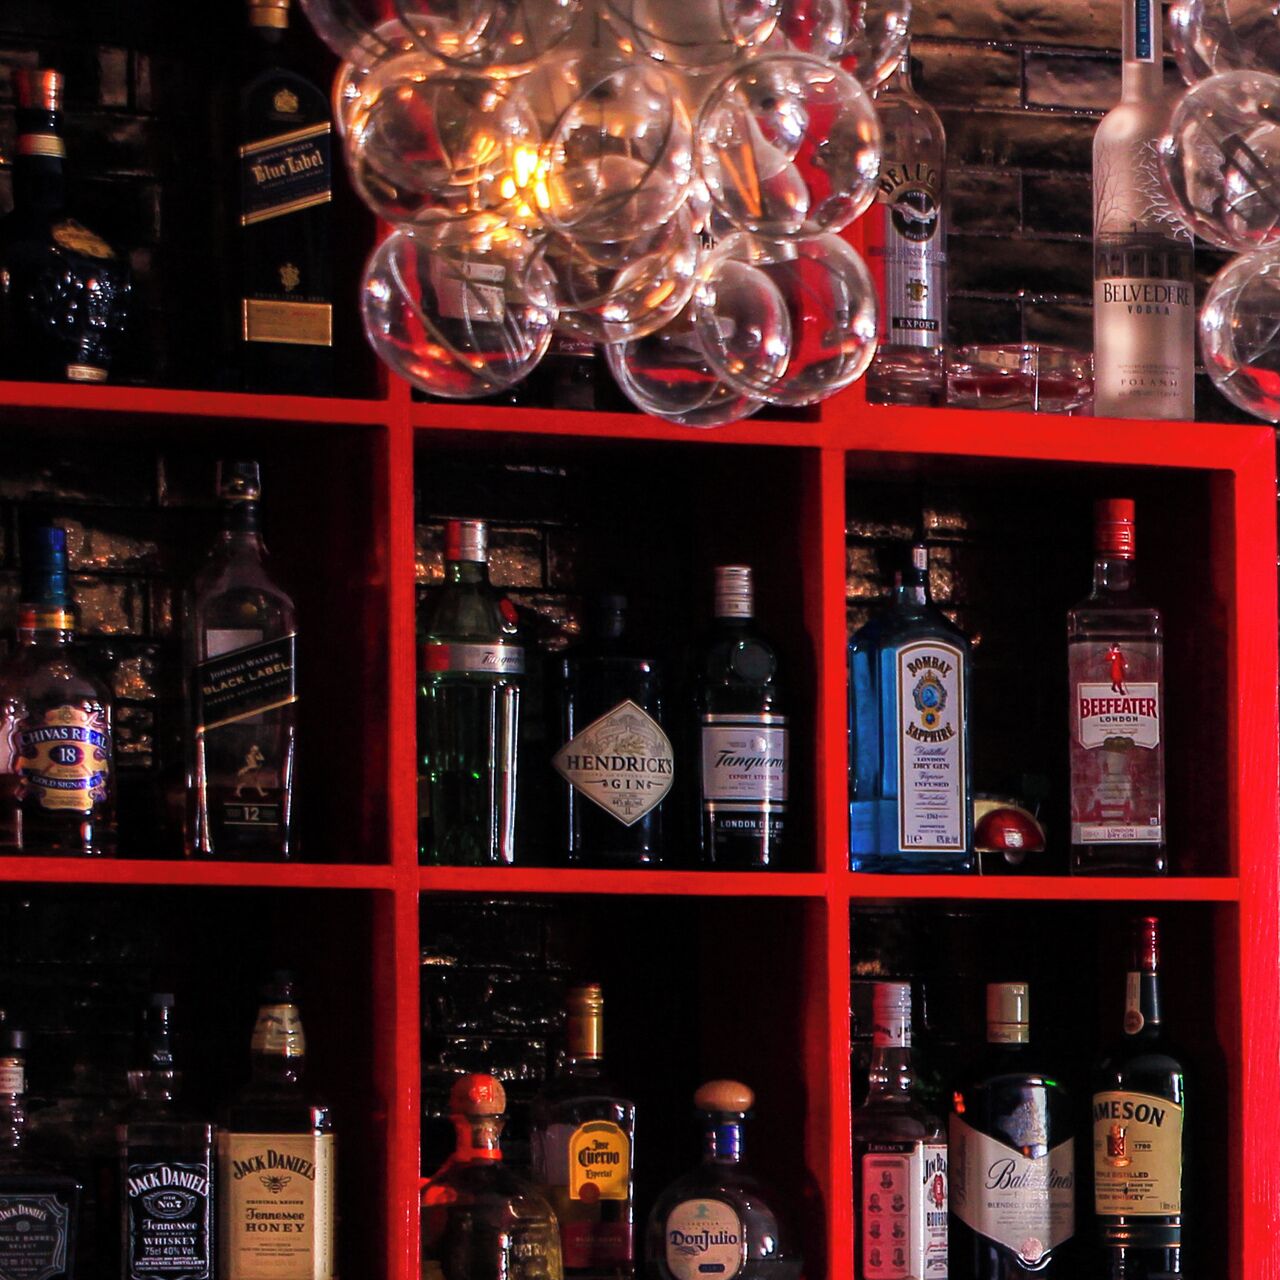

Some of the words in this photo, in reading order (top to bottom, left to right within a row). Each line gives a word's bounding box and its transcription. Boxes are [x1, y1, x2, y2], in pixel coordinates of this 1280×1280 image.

[252, 164, 287, 184] Blue
[285, 149, 325, 174] Label
[1103, 282, 1190, 306] BELVEDERE
[1127, 304, 1170, 316] VODKA
[900, 318, 936, 331] EXPORT
[906, 656, 953, 678] BOMBAY
[203, 676, 245, 695] BLACK
[249, 662, 289, 681] LABEL
[1080, 697, 1157, 719] BEEFEATER
[1099, 715, 1139, 723] LONDON
[22, 727, 69, 745] CHIVAS
[905, 721, 957, 743] SAPPHIRE
[60, 747, 77, 763] 18
[611, 779, 645, 790] GIN
[244, 807, 259, 821] 12
[720, 820, 751, 828] LONDON
[868, 1143, 905, 1151] LEGACY
[578, 1146, 620, 1168] Cuervo
[233, 1154, 266, 1180] JACK
[128, 1172, 161, 1197] JACK
[157, 1200, 183, 1210] No.7
[245, 1207, 305, 1221] Tennessee
[143, 1219, 198, 1231] Tennessee
[245, 1223, 305, 1234] HONEY
[144, 1237, 197, 1246] WHISKEY
[163, 1246, 180, 1256] 40%
